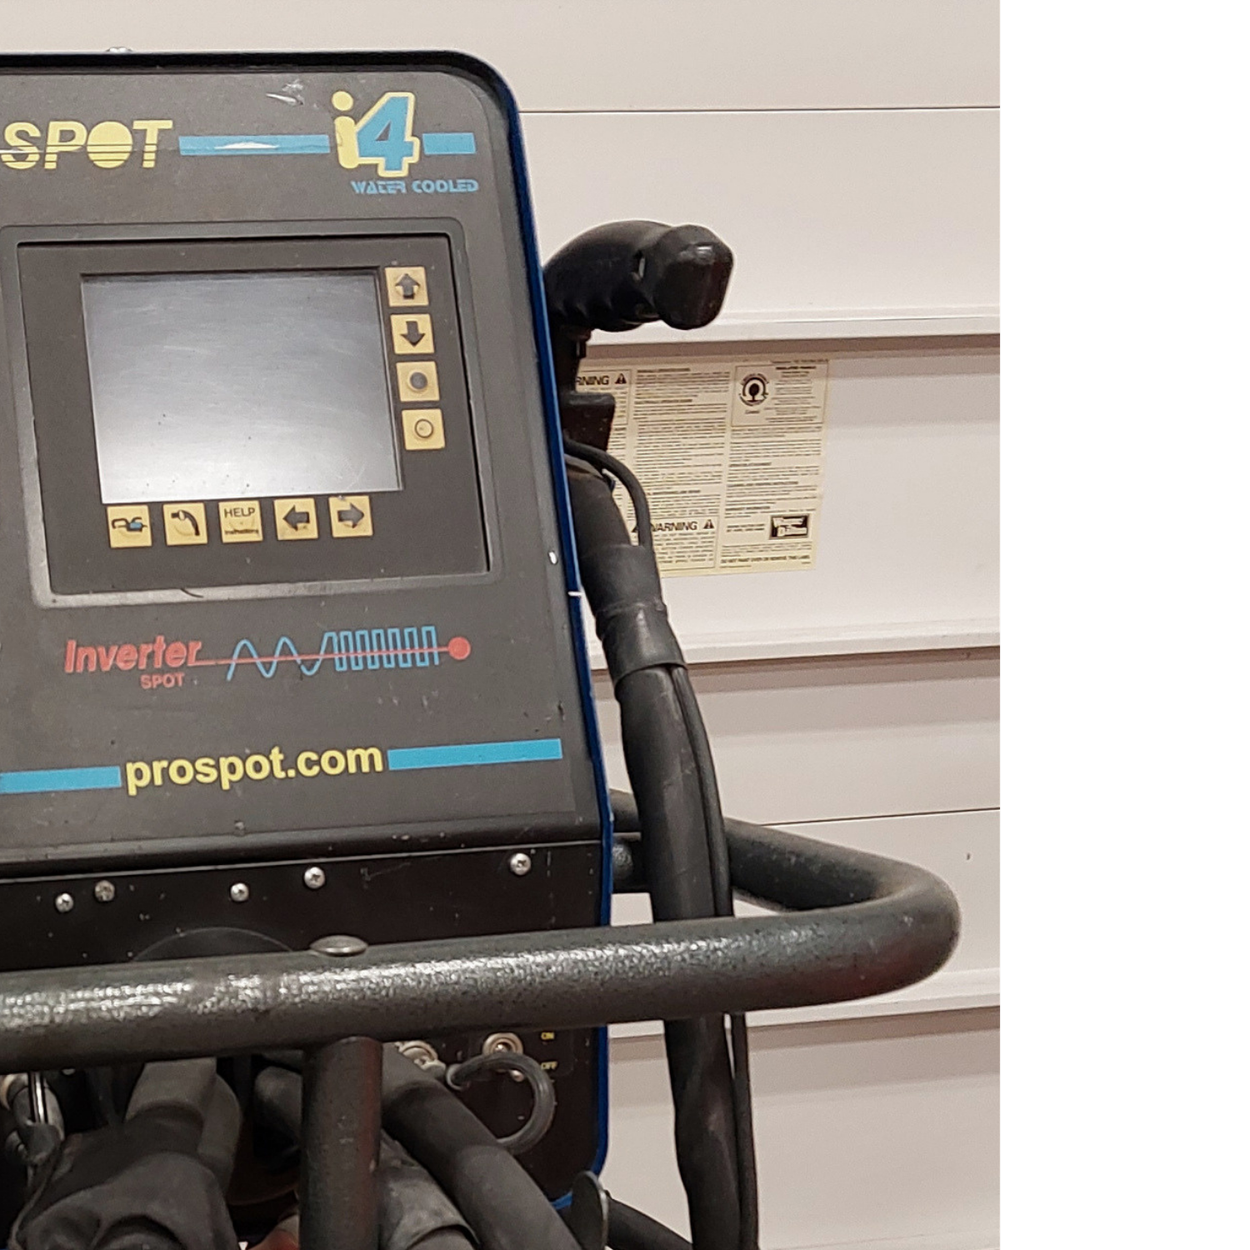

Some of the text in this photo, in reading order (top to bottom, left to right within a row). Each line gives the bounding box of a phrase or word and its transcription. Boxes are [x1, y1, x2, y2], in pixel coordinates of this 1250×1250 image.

[0, 119, 173, 170] SPOT
[331, 90, 421, 177] i4
[350, 178, 480, 195] WATER COOLED
[576, 375, 610, 386] RNING
[224, 507, 256, 518] HELP
[65, 635, 202, 673] Inverter
[140, 672, 185, 689] SPOT
[125, 746, 385, 797] prospot.com
